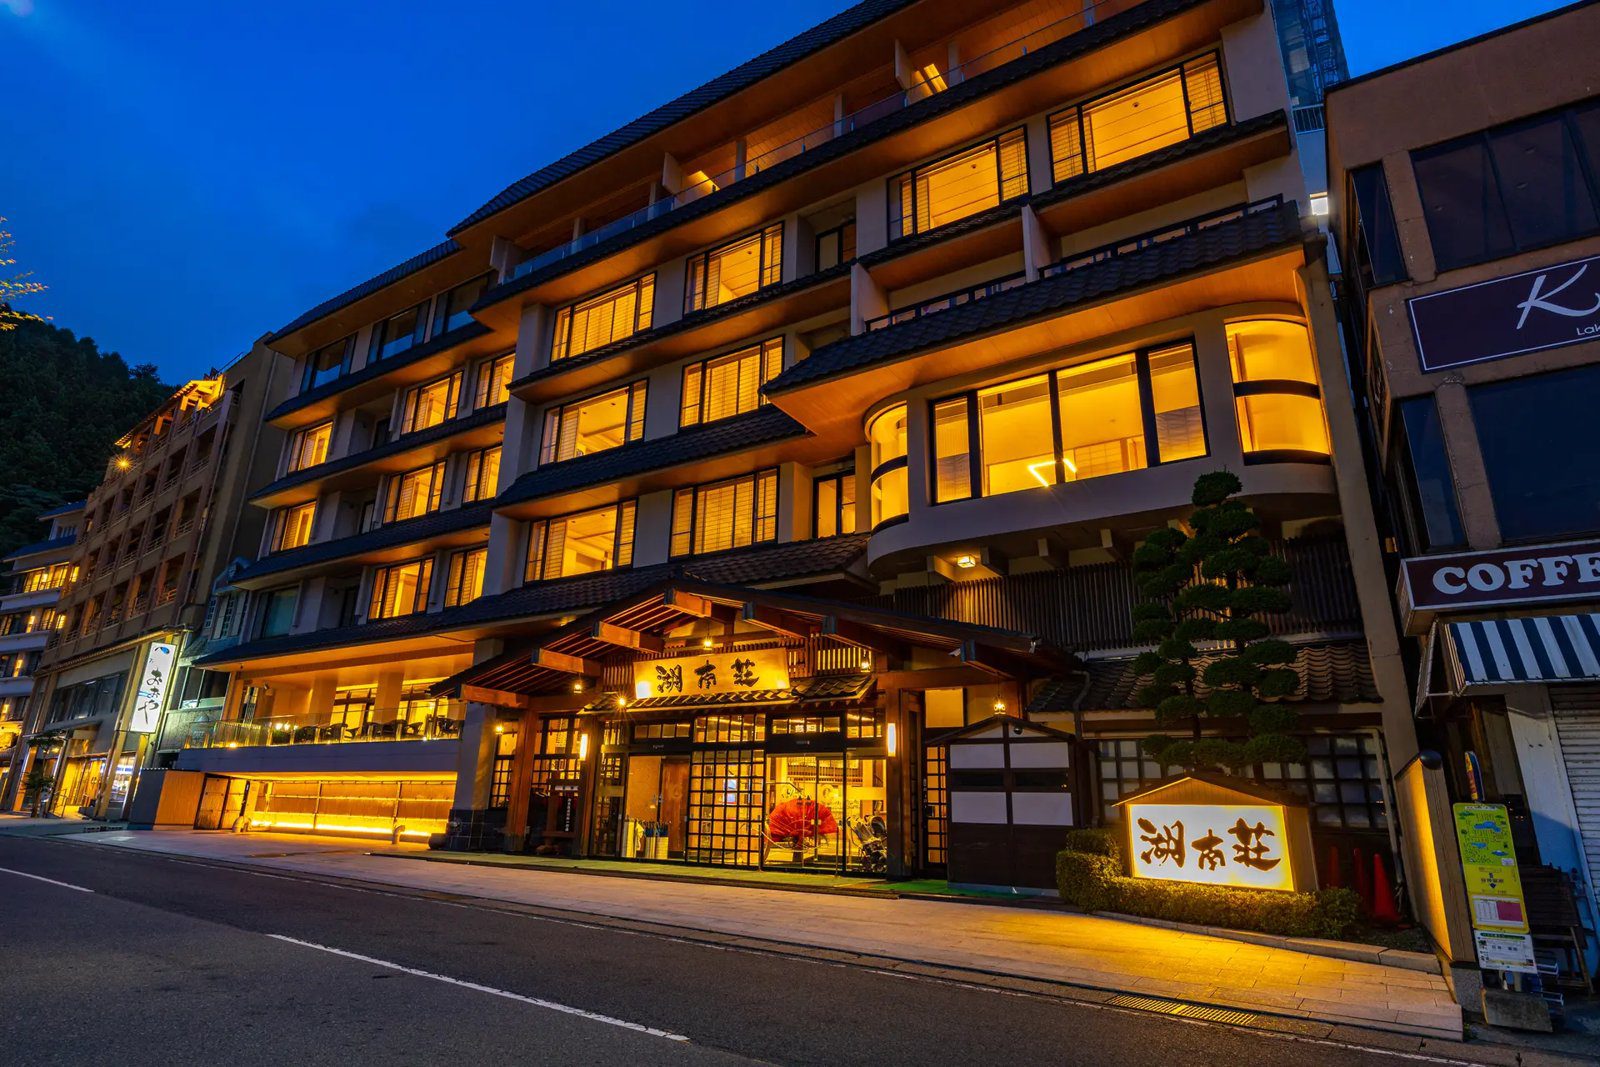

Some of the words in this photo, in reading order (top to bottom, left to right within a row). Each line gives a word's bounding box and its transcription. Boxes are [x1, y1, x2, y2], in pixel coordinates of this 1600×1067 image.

[655, 657, 760, 694] 湖南荘
[1137, 817, 1282, 872] 湖南荘
